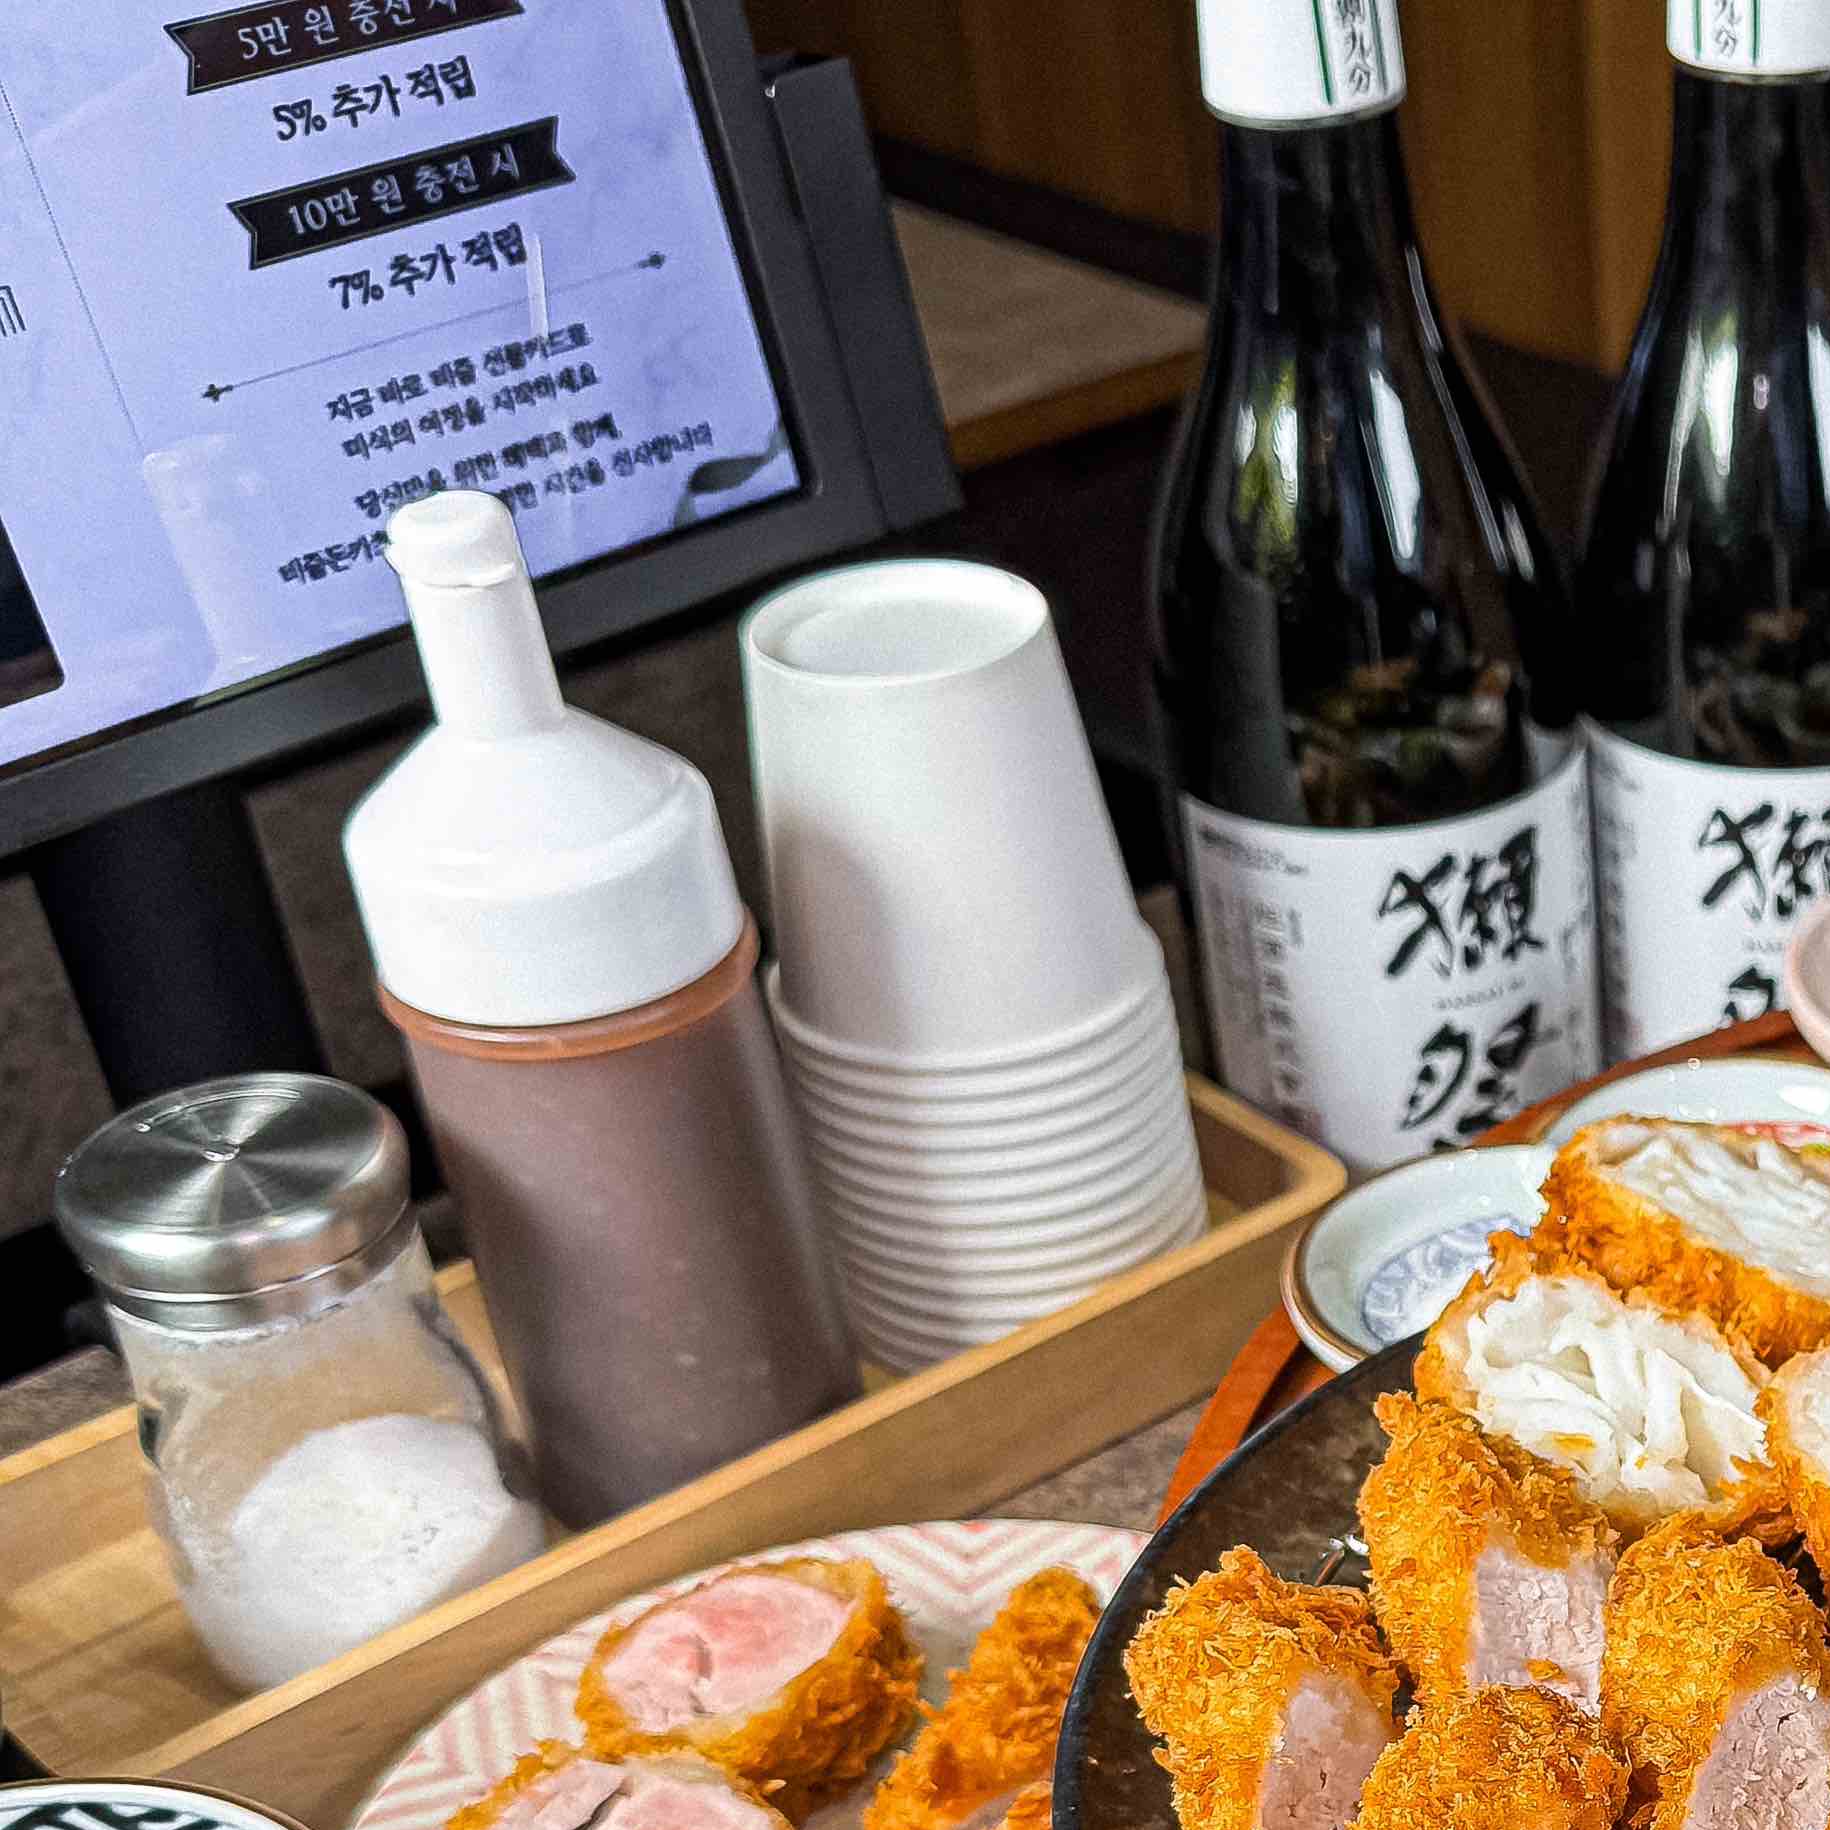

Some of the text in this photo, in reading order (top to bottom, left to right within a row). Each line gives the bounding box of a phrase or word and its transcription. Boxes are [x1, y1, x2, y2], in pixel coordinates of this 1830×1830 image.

[237, 17, 292, 60] 5만
[304, 4, 340, 45] 원
[272, 55, 477, 141] 5% 추가 적립
[288, 143, 520, 234] 10만 원 충전 시
[328, 222, 527, 309] 7% 추가 적립
[326, 387, 374, 421] 지금
[376, 374, 428, 404] 바로
[341, 418, 415, 460] 미식의
